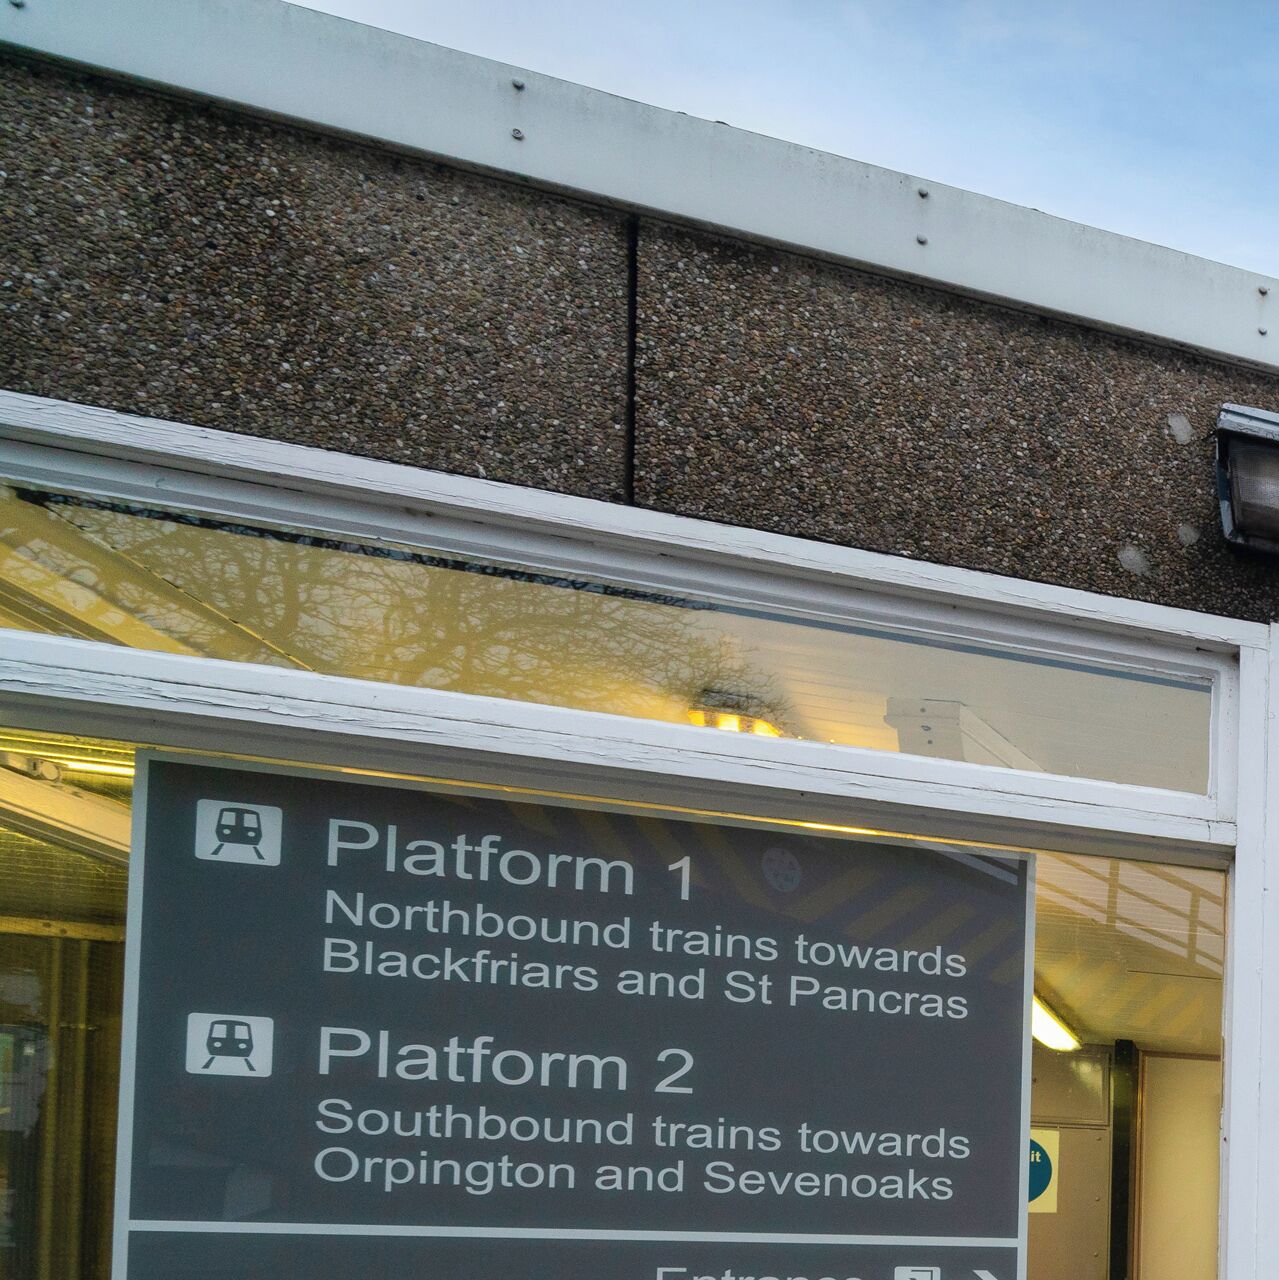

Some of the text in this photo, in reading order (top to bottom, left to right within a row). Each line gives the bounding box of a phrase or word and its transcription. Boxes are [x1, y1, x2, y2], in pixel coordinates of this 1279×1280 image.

[327, 818, 691, 900] Platform 1
[325, 889, 967, 978] Northbound trains towards
[323, 937, 968, 1020] Blackfriars and St Pancras
[318, 1026, 694, 1095] Platform 2
[315, 1098, 971, 1159] Southbound trains towards
[314, 1146, 954, 1200] Orpington and Sevenoaks
